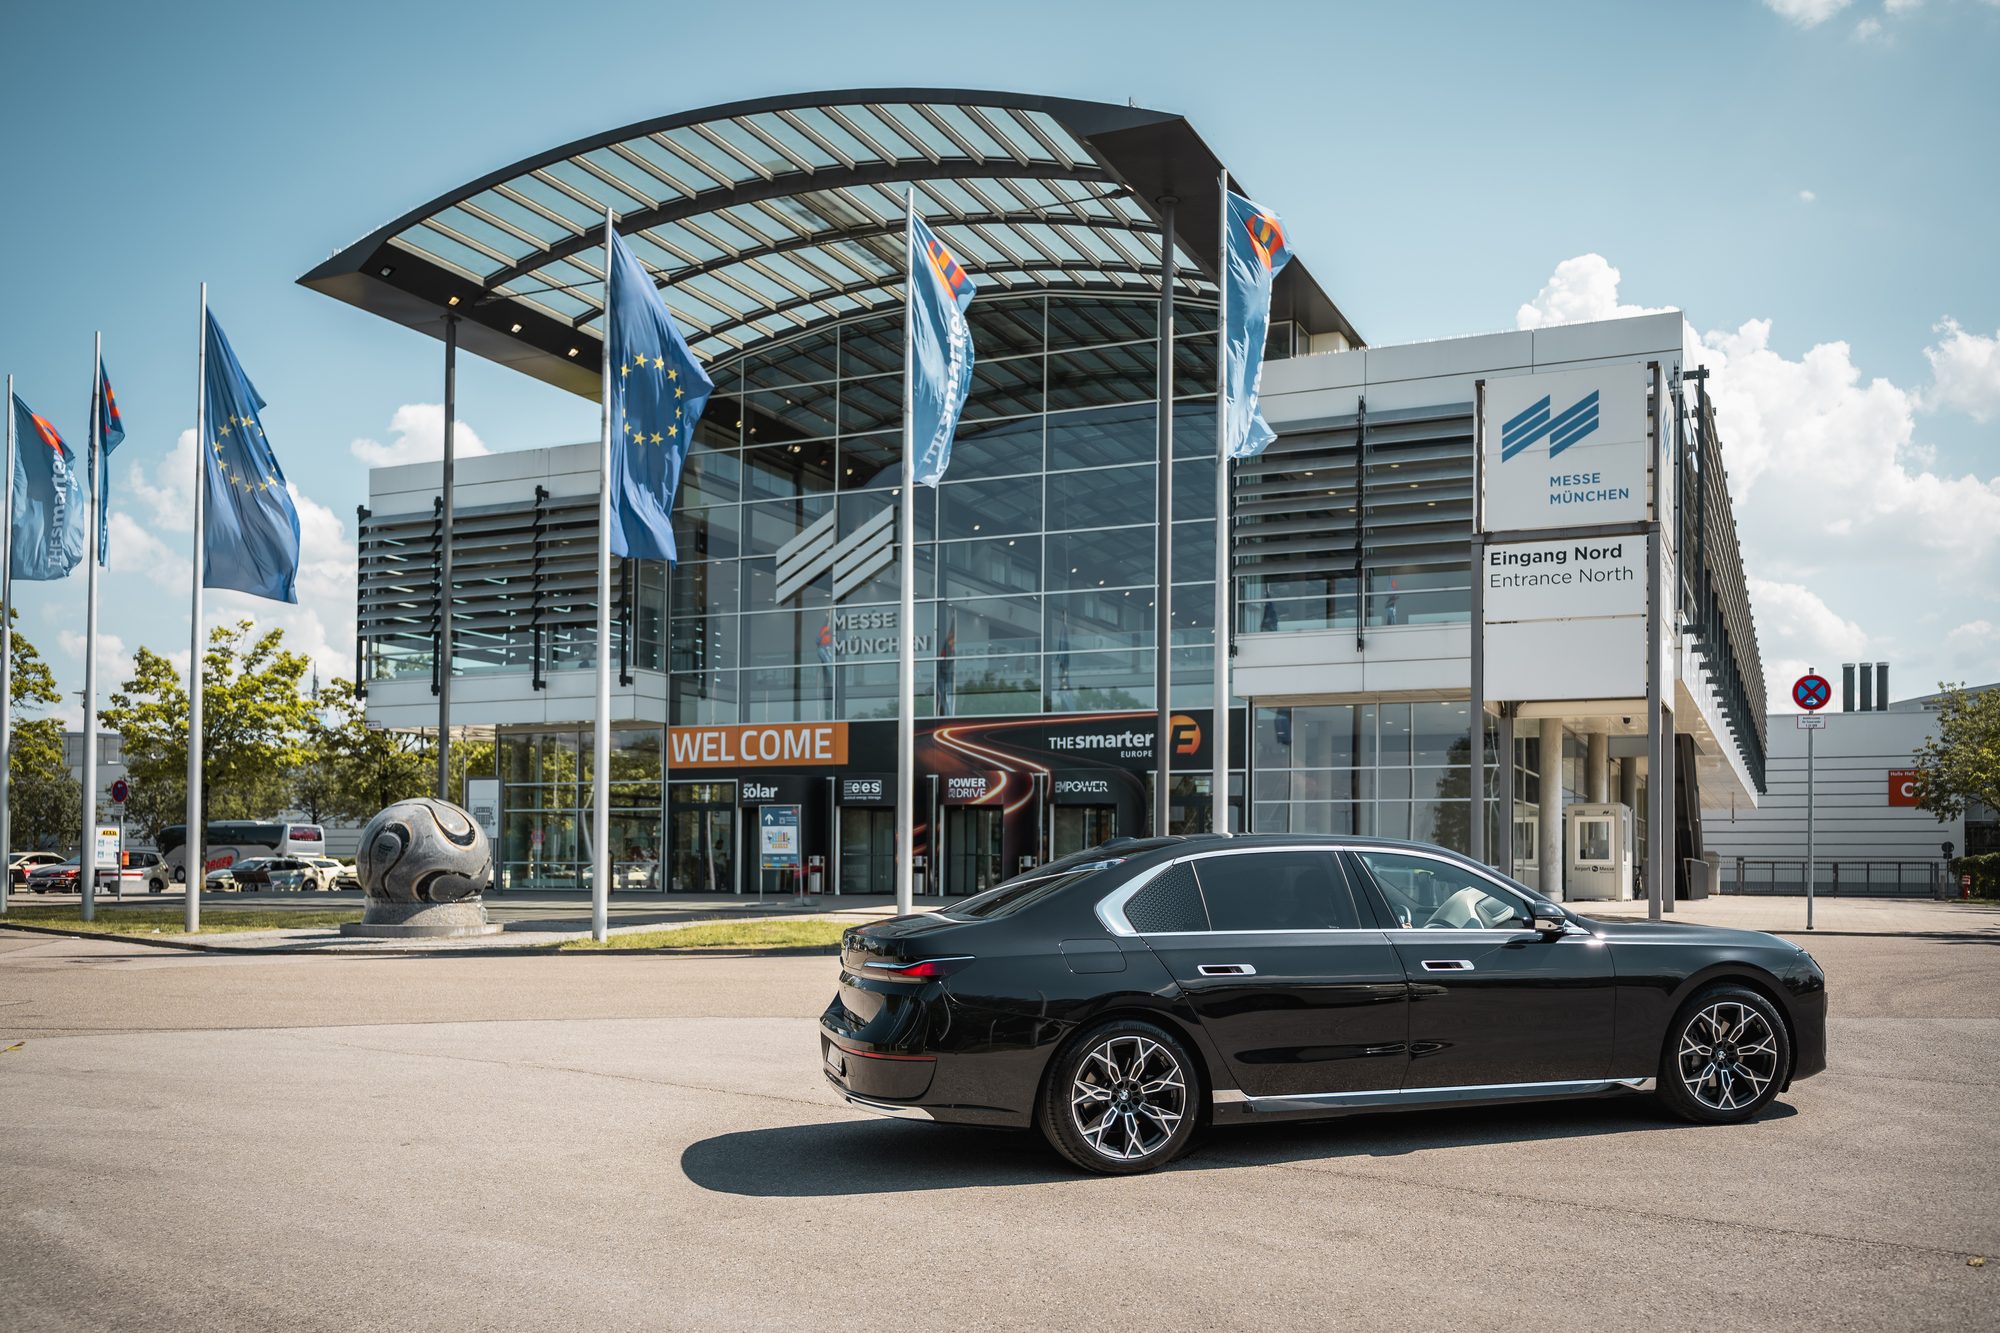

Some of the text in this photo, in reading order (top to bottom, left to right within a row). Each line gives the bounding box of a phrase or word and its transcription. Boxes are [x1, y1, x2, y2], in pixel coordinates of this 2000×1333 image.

[1549, 472, 1601, 488] MESSE
[1549, 487, 1629, 505] MÜNCHEN
[1490, 544, 1622, 566] Eingang Nord
[1490, 566, 1633, 588] Entrance North
[833, 612, 894, 630] MESSE
[834, 634, 928, 655] MÜNCHN
[671, 728, 833, 763] WELCOME
[1120, 750, 1153, 758] EUROPE
[743, 783, 778, 798] solar
[851, 782, 880, 793] ees
[948, 778, 986, 788] POWER
